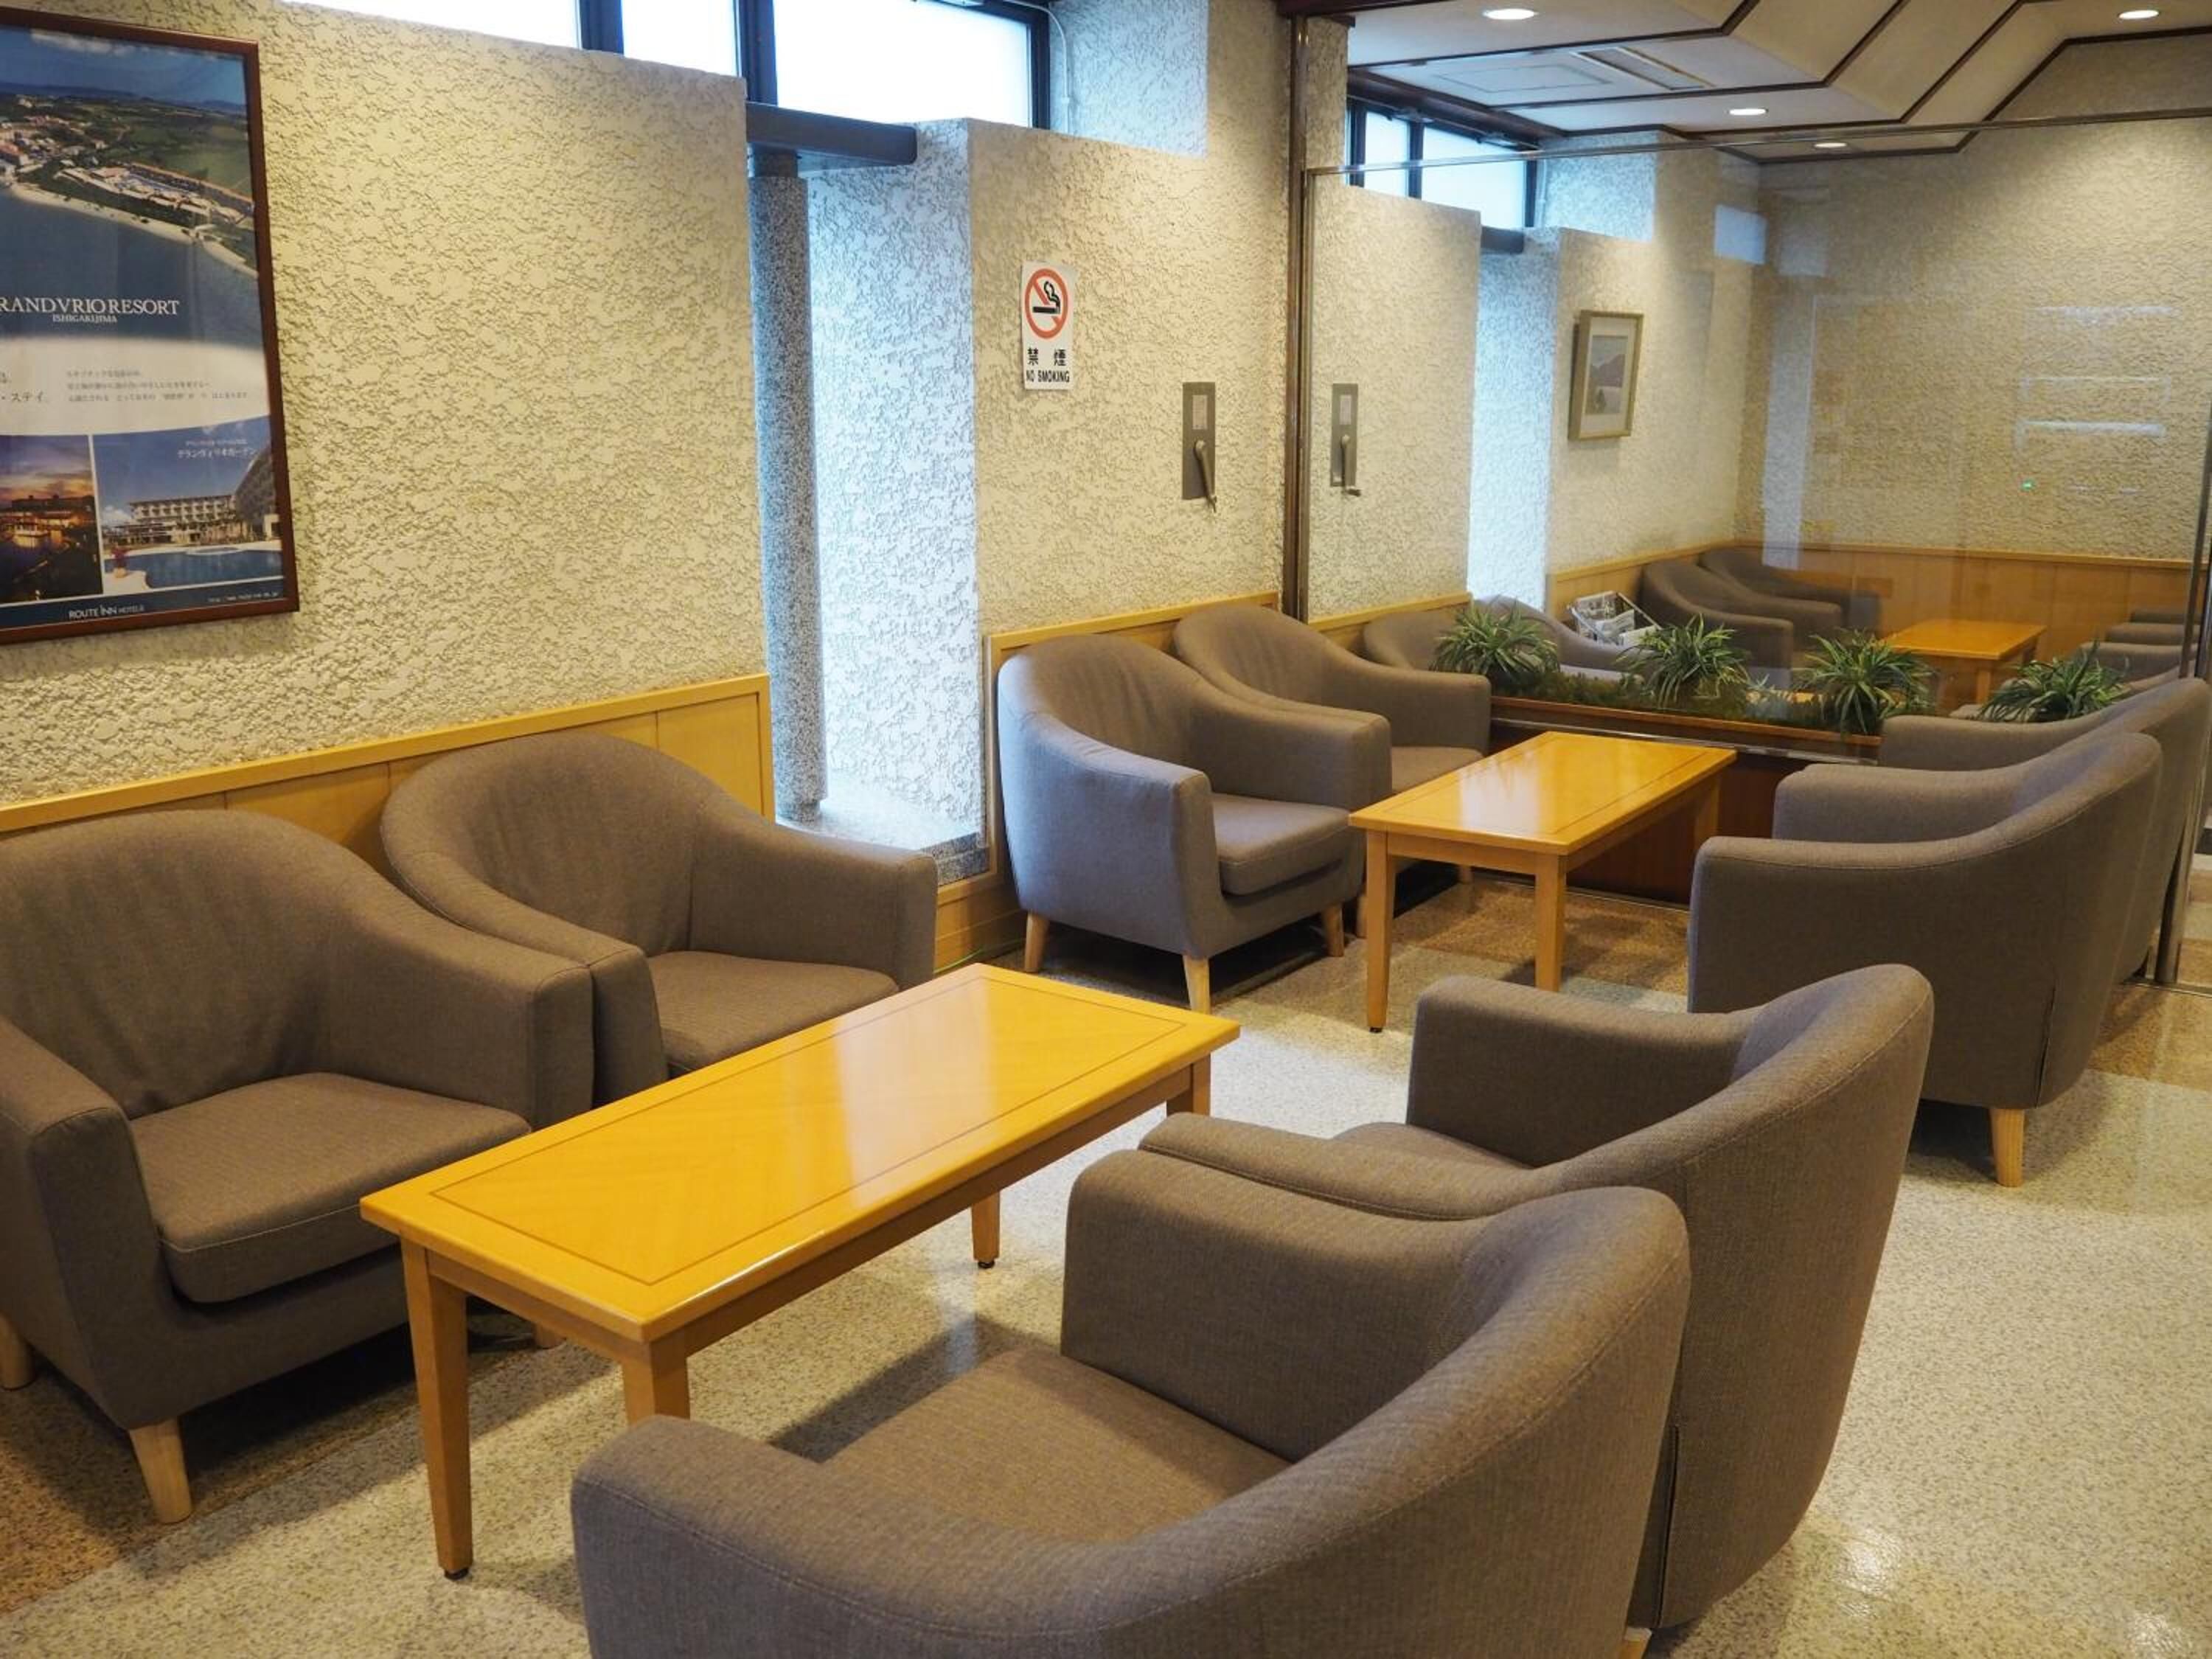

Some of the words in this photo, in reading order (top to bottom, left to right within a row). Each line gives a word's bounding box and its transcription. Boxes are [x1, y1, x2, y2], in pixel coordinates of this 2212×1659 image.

[108, 299, 179, 315] RESORT
[52, 313, 117, 323] ISHIGAKIJIMA
[1026, 369, 1034, 382] NO
[1037, 370, 1070, 383] SMOKING
[69, 609, 99, 619] ROUTE
